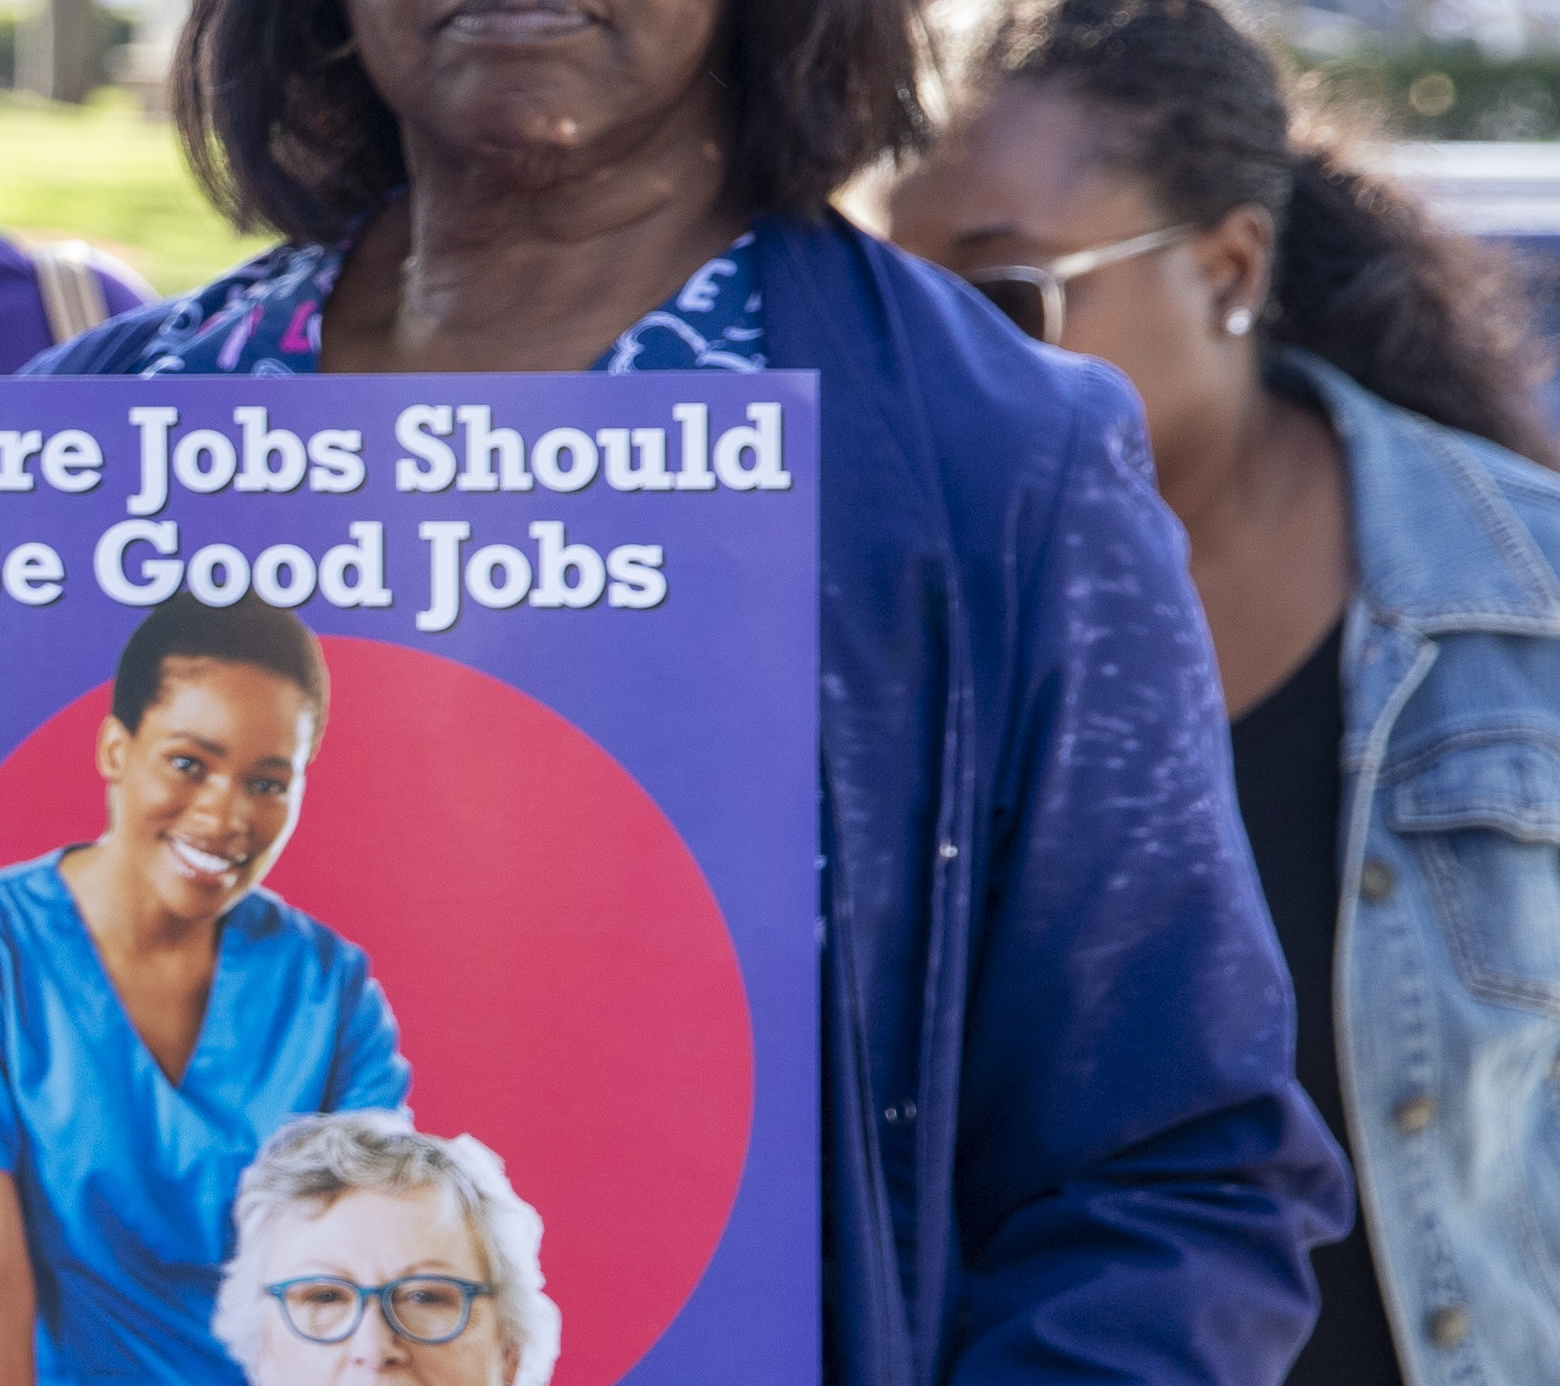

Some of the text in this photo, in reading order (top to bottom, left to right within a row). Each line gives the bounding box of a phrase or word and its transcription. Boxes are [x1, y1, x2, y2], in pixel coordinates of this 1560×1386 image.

[127, 405, 367, 515] Jobs
[394, 402, 792, 493] Should
[93, 518, 393, 608] Good
[415, 519, 668, 632] Jobs
